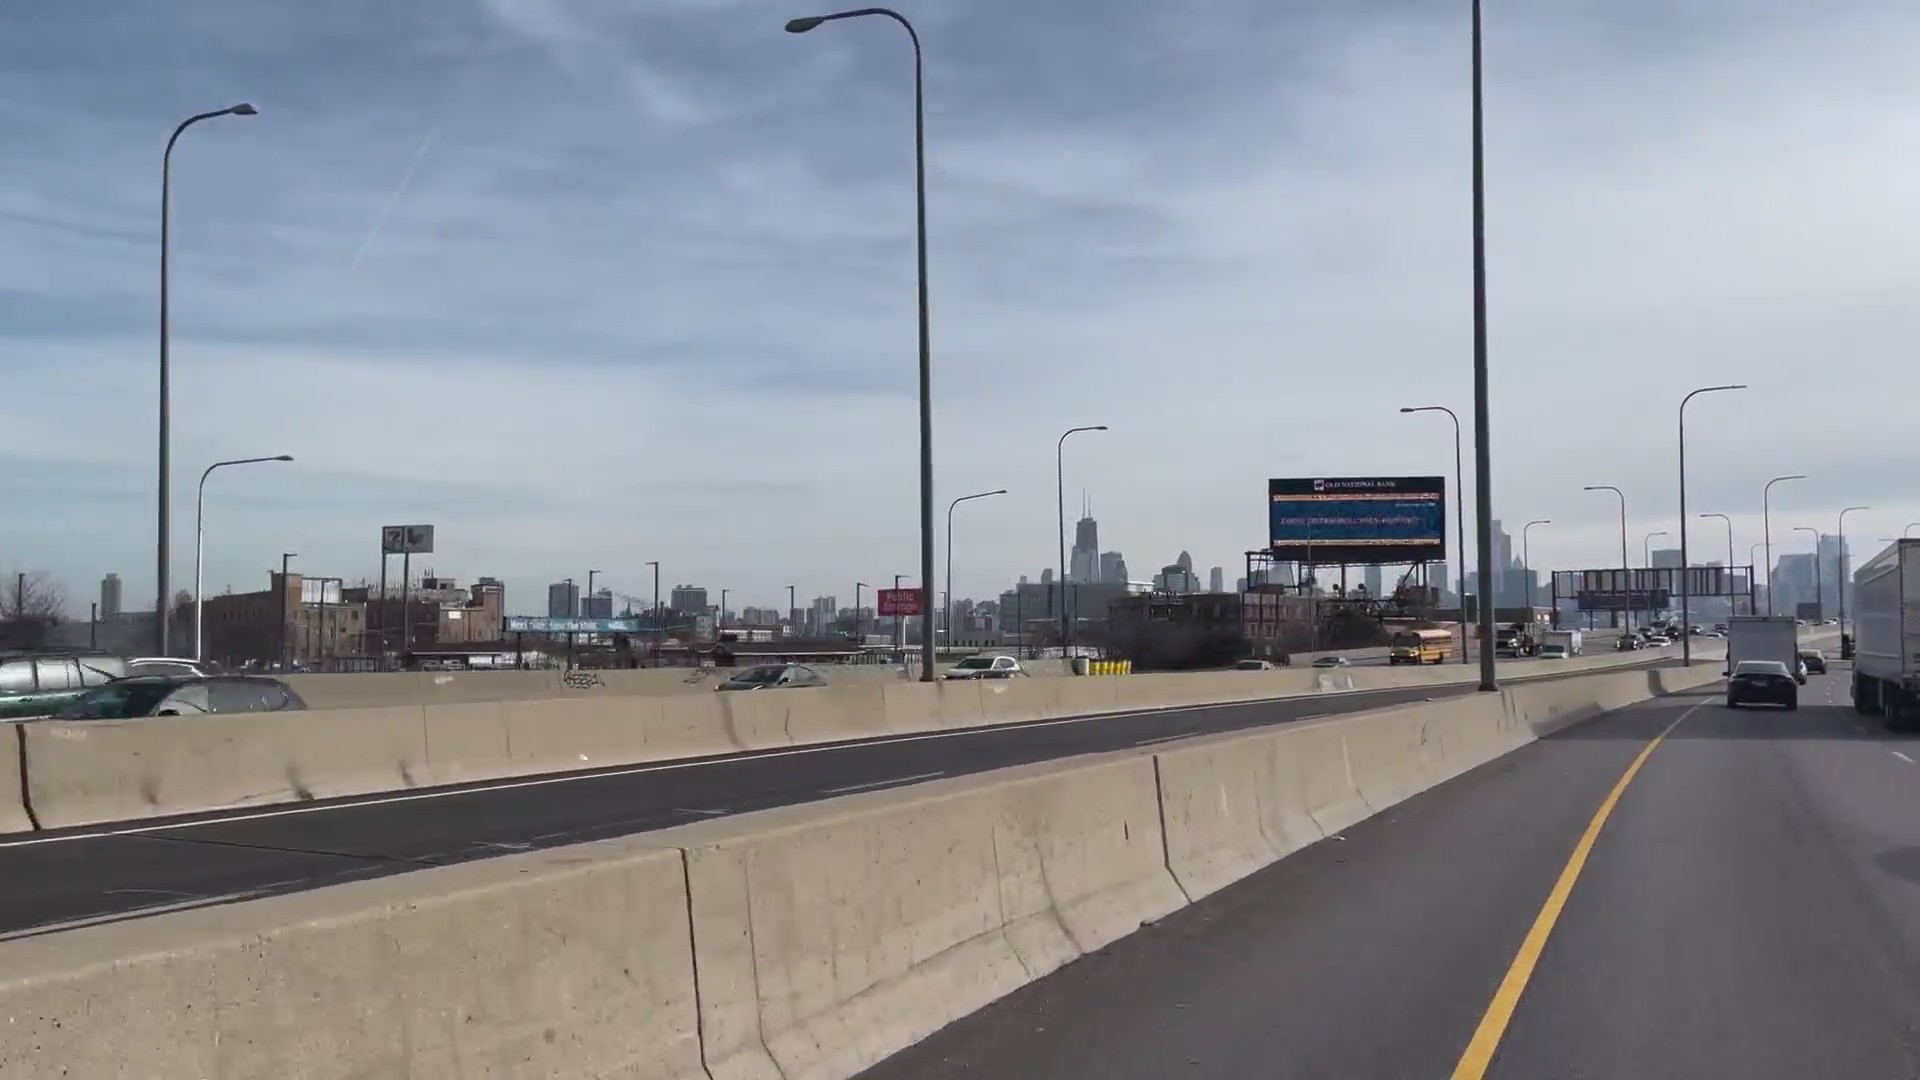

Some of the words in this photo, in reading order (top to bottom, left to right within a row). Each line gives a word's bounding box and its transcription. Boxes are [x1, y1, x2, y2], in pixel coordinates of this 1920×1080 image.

[1325, 481, 1340, 489] OLD
[1341, 480, 1376, 488] NATIONAL
[1377, 480, 1397, 488] BANK
